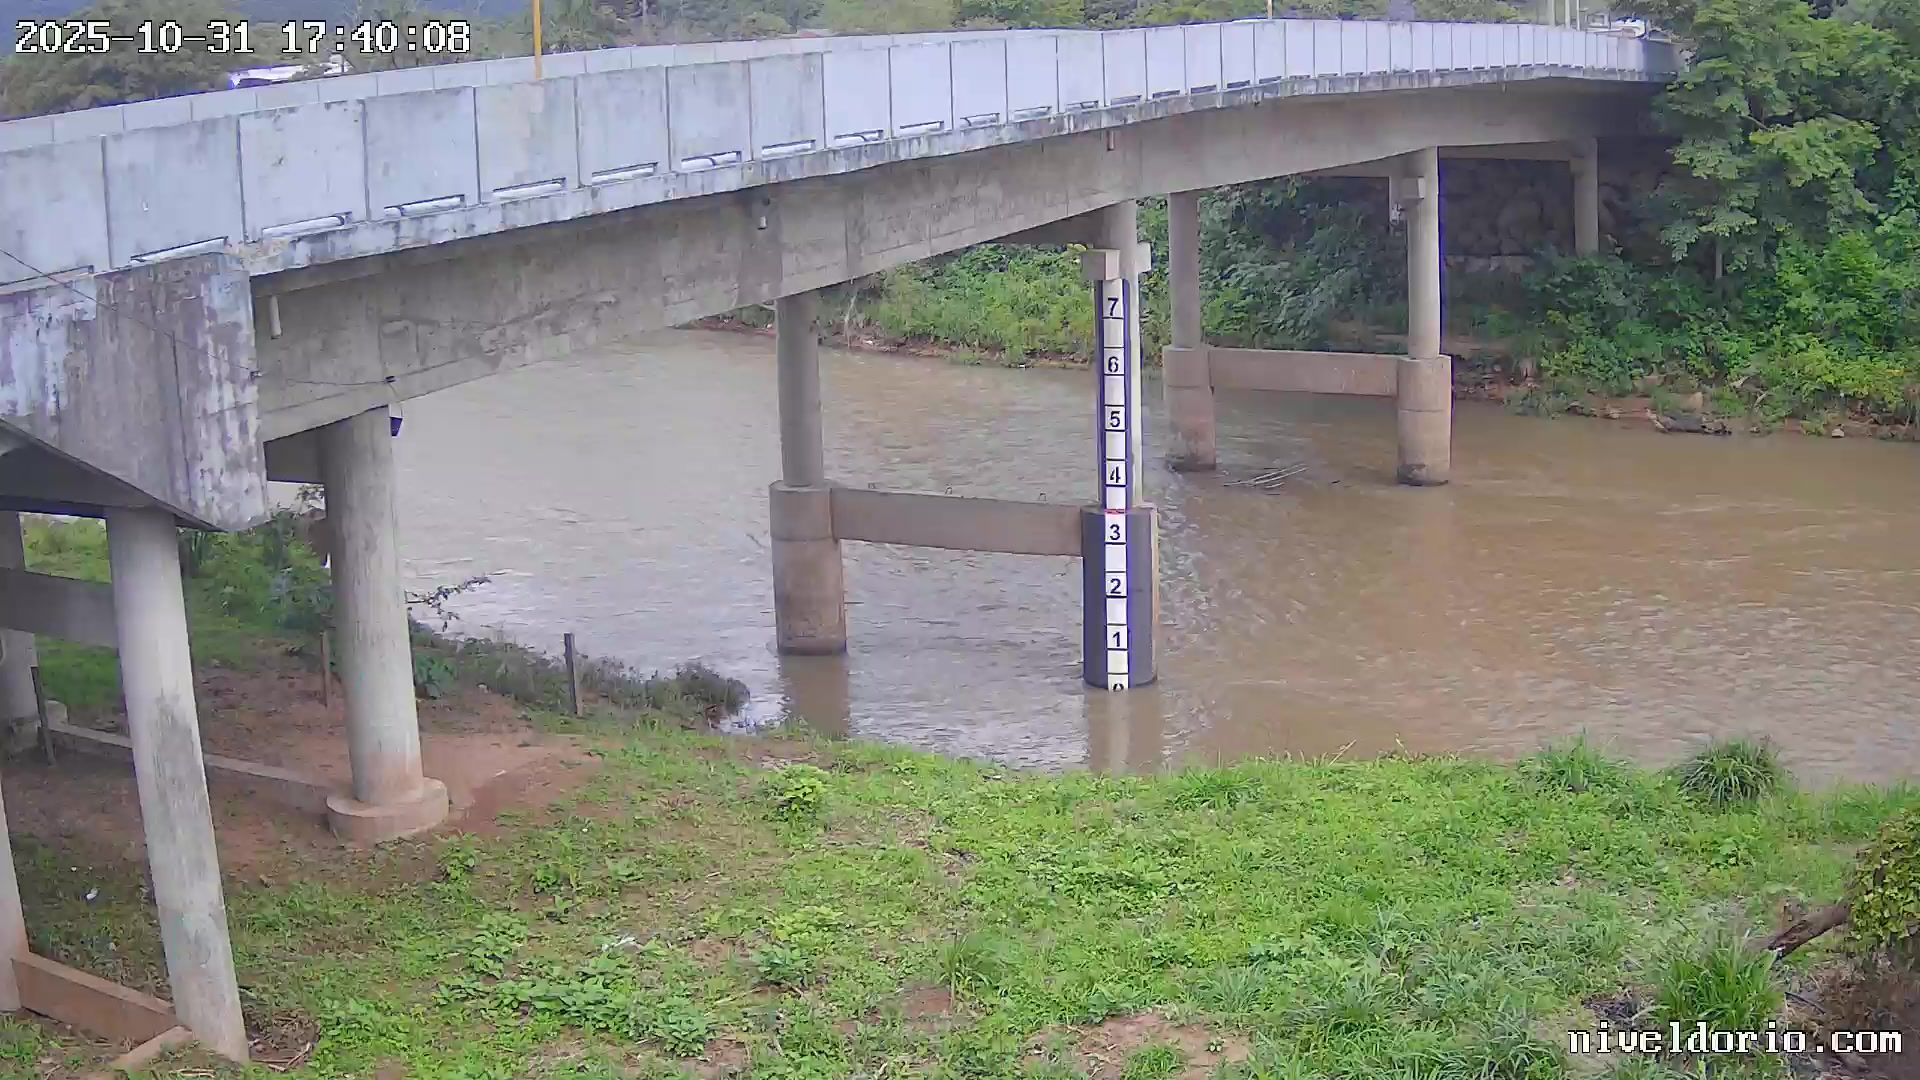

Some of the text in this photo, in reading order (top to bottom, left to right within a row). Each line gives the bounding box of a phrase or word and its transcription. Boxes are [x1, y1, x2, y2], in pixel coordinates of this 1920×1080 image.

[1107, 297, 1119, 317] 7
[1107, 356, 1119, 373] 6
[1109, 411, 1121, 427] 5
[1109, 466, 1121, 483] 4
[1109, 523, 1121, 540] 3
[1110, 578, 1121, 594] 2
[1112, 632, 1120, 647] 1
